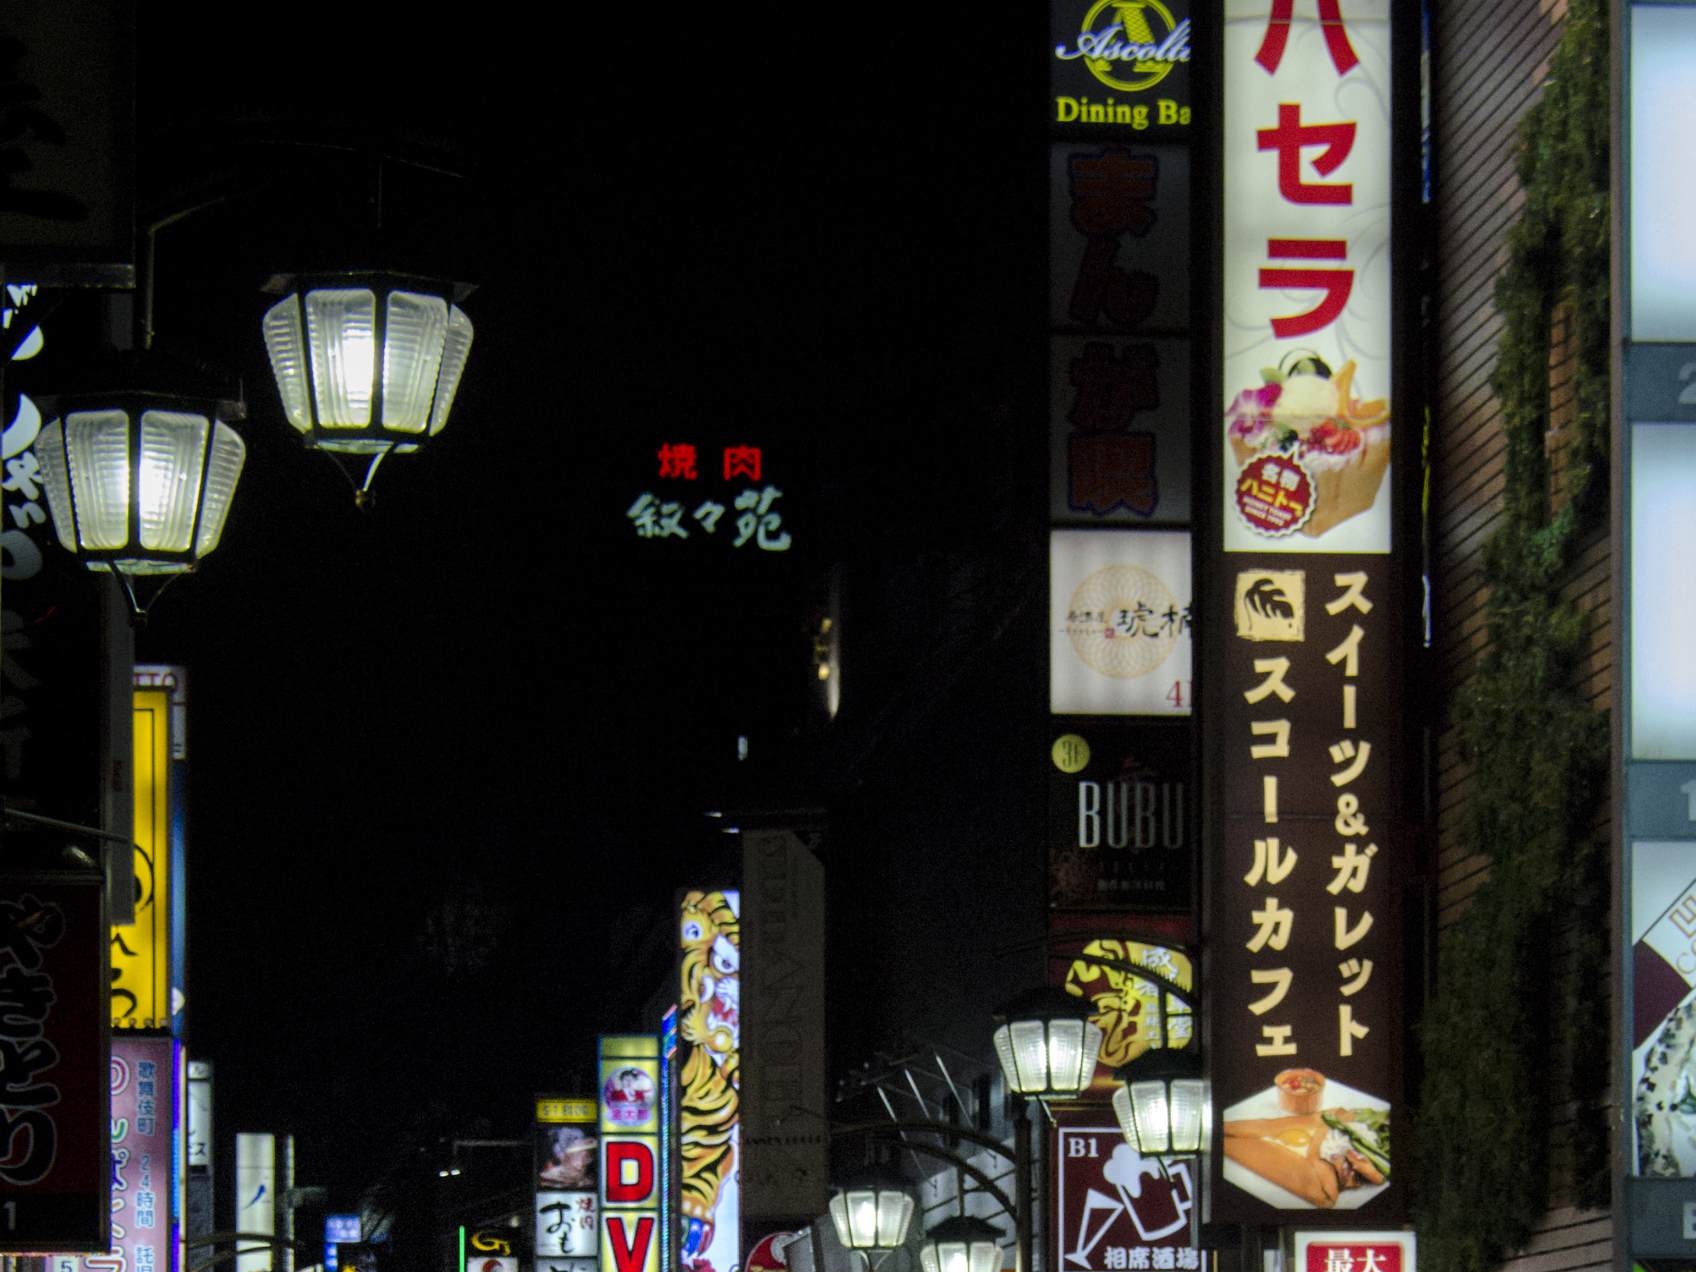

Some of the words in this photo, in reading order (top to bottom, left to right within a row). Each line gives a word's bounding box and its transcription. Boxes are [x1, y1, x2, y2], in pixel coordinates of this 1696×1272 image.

[1056, 96, 1149, 130] Dining
[657, 442, 762, 481] 焼肉
[1078, 781, 1185, 849] BUBU
[1322, 570, 1379, 1057] スイーツ&ガレット
[1242, 655, 1299, 1057] スコールカフェ
[1068, 1137, 1099, 1158] B1
[1104, 1246, 1199, 1270] 相席酒場
